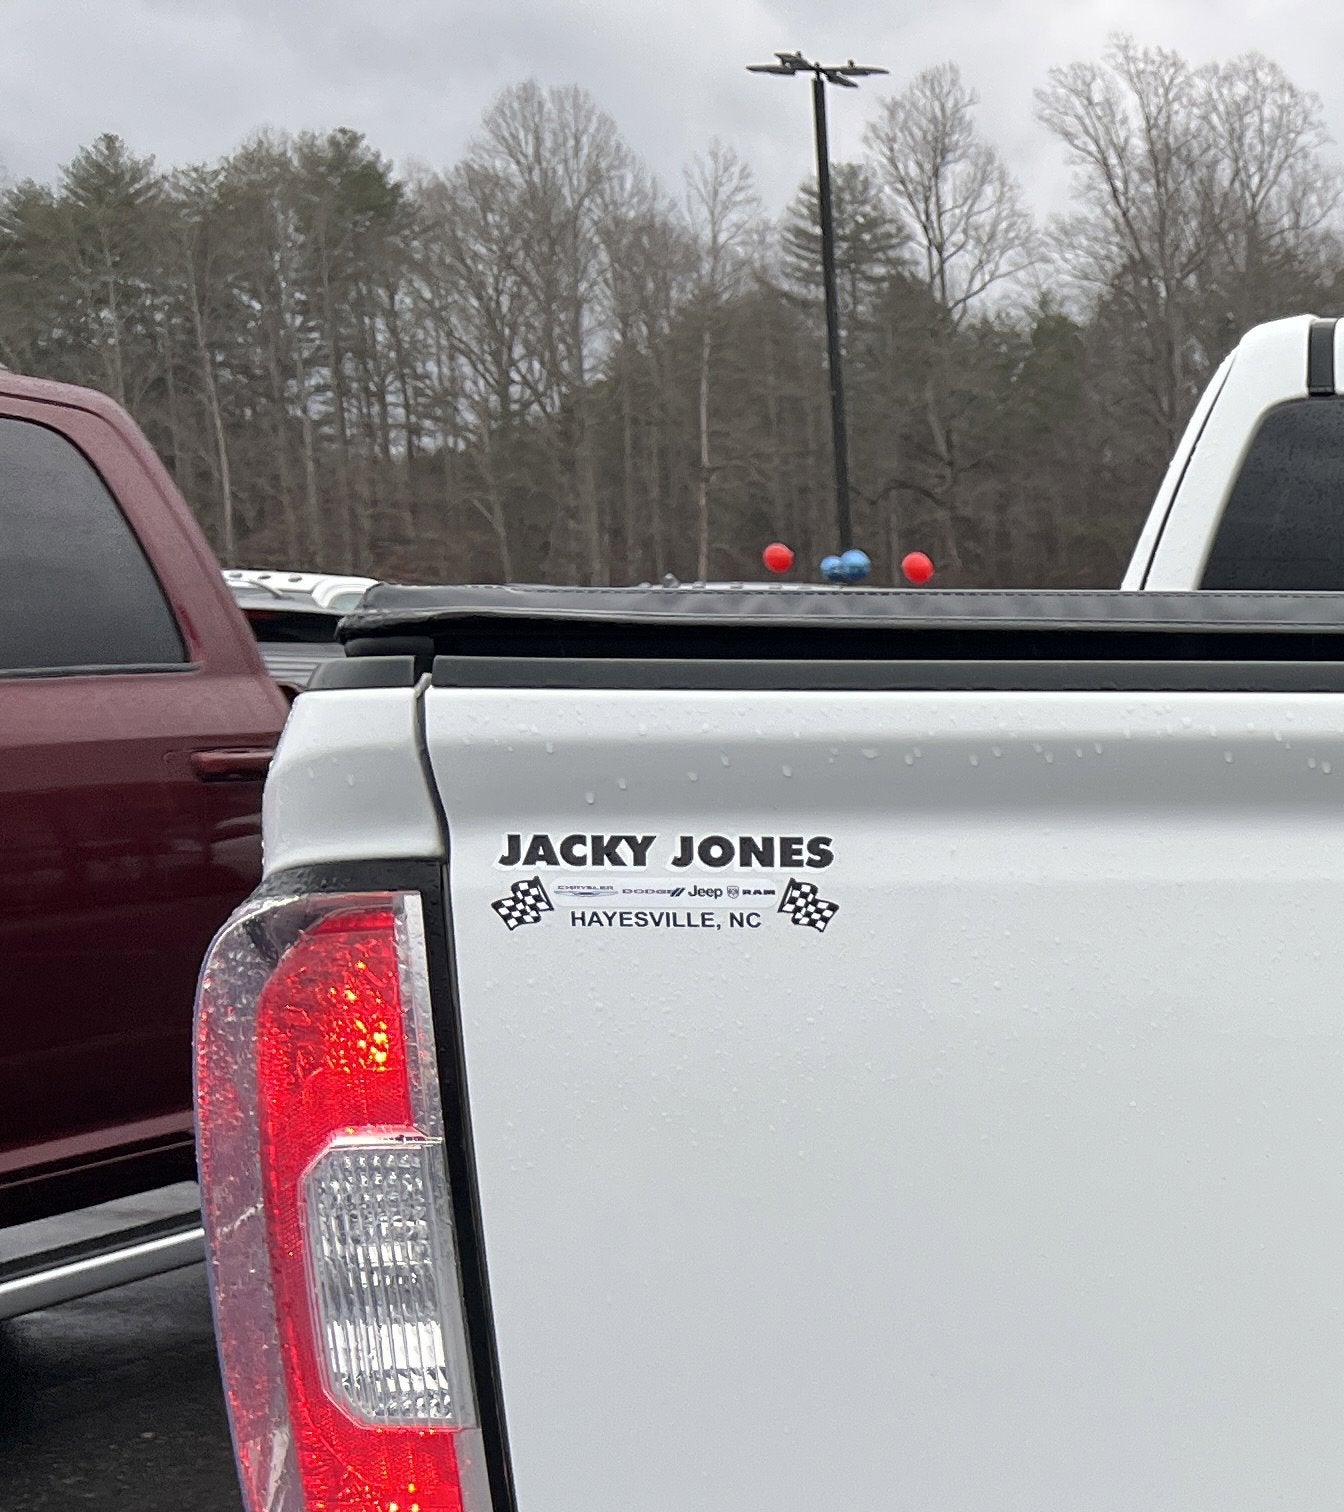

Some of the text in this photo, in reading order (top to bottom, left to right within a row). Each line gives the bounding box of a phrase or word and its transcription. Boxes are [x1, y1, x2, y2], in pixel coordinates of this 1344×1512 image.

[498, 834, 834, 868] JACKY JONES
[688, 885, 723, 900] Jeep
[742, 888, 776, 896] RAM
[570, 911, 762, 930] HAYESVILLE, NC
